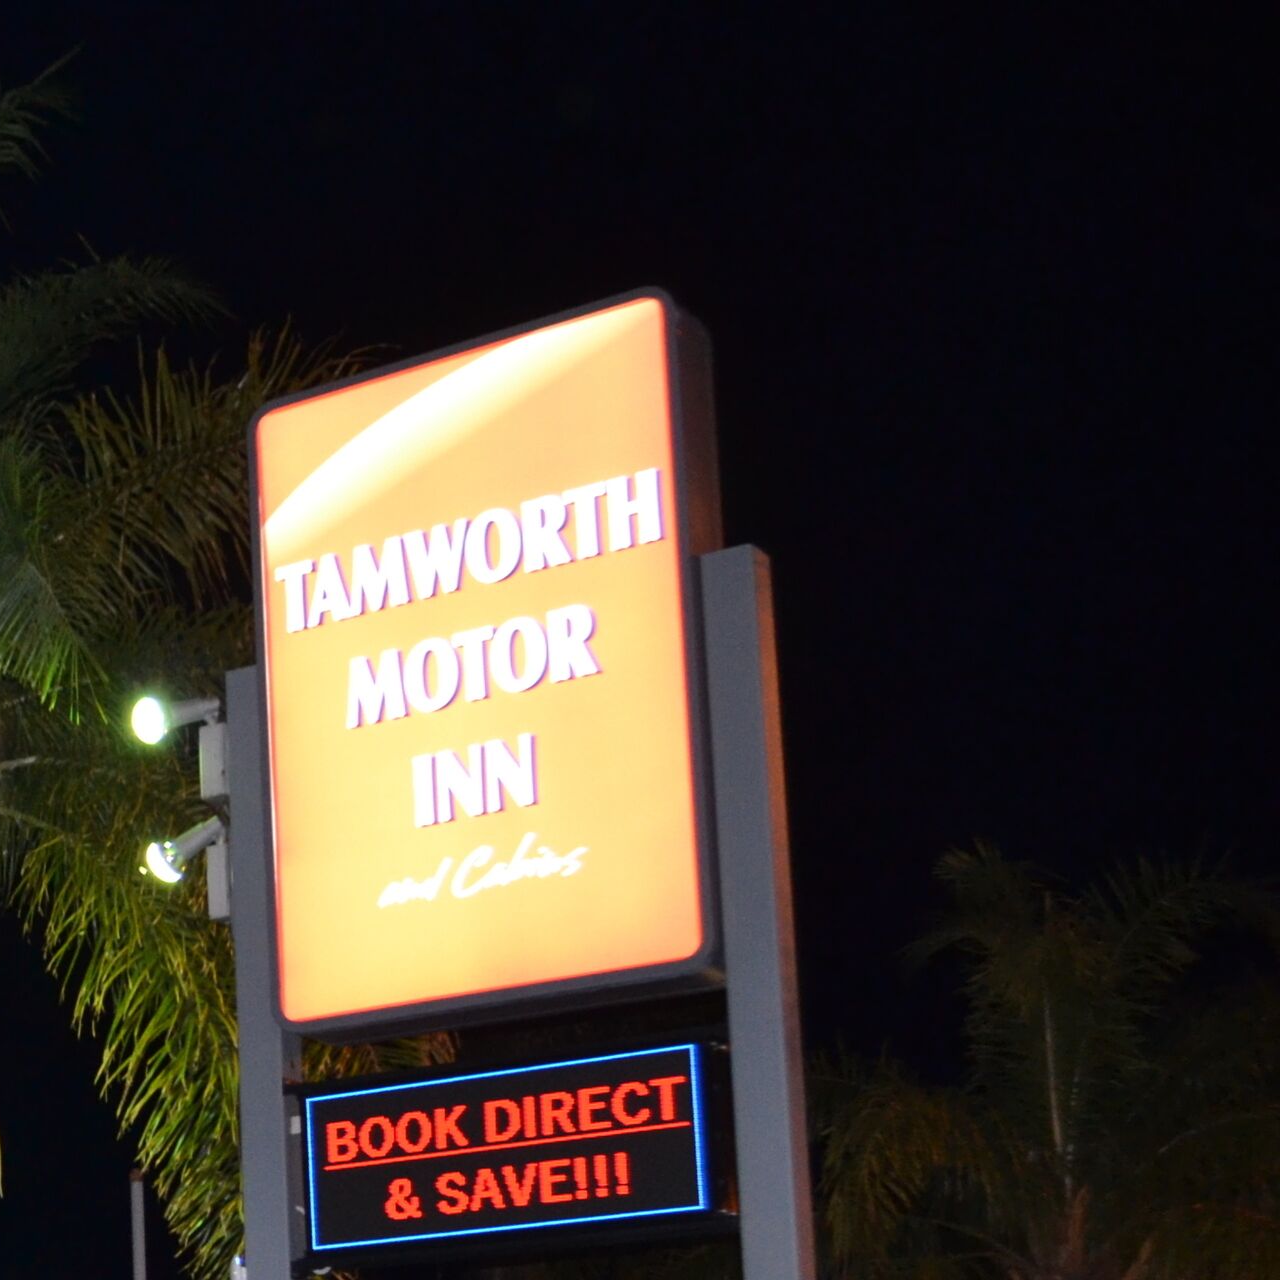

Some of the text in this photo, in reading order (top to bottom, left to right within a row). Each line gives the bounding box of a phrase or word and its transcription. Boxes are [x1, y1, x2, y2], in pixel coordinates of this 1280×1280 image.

[274, 467, 666, 633] TAMWORTH
[345, 604, 601, 730] MOTOR
[411, 732, 539, 829] INN
[323, 1075, 688, 1163] BOOK DIRECT
[384, 1151, 632, 1221] & SAVE!!!
